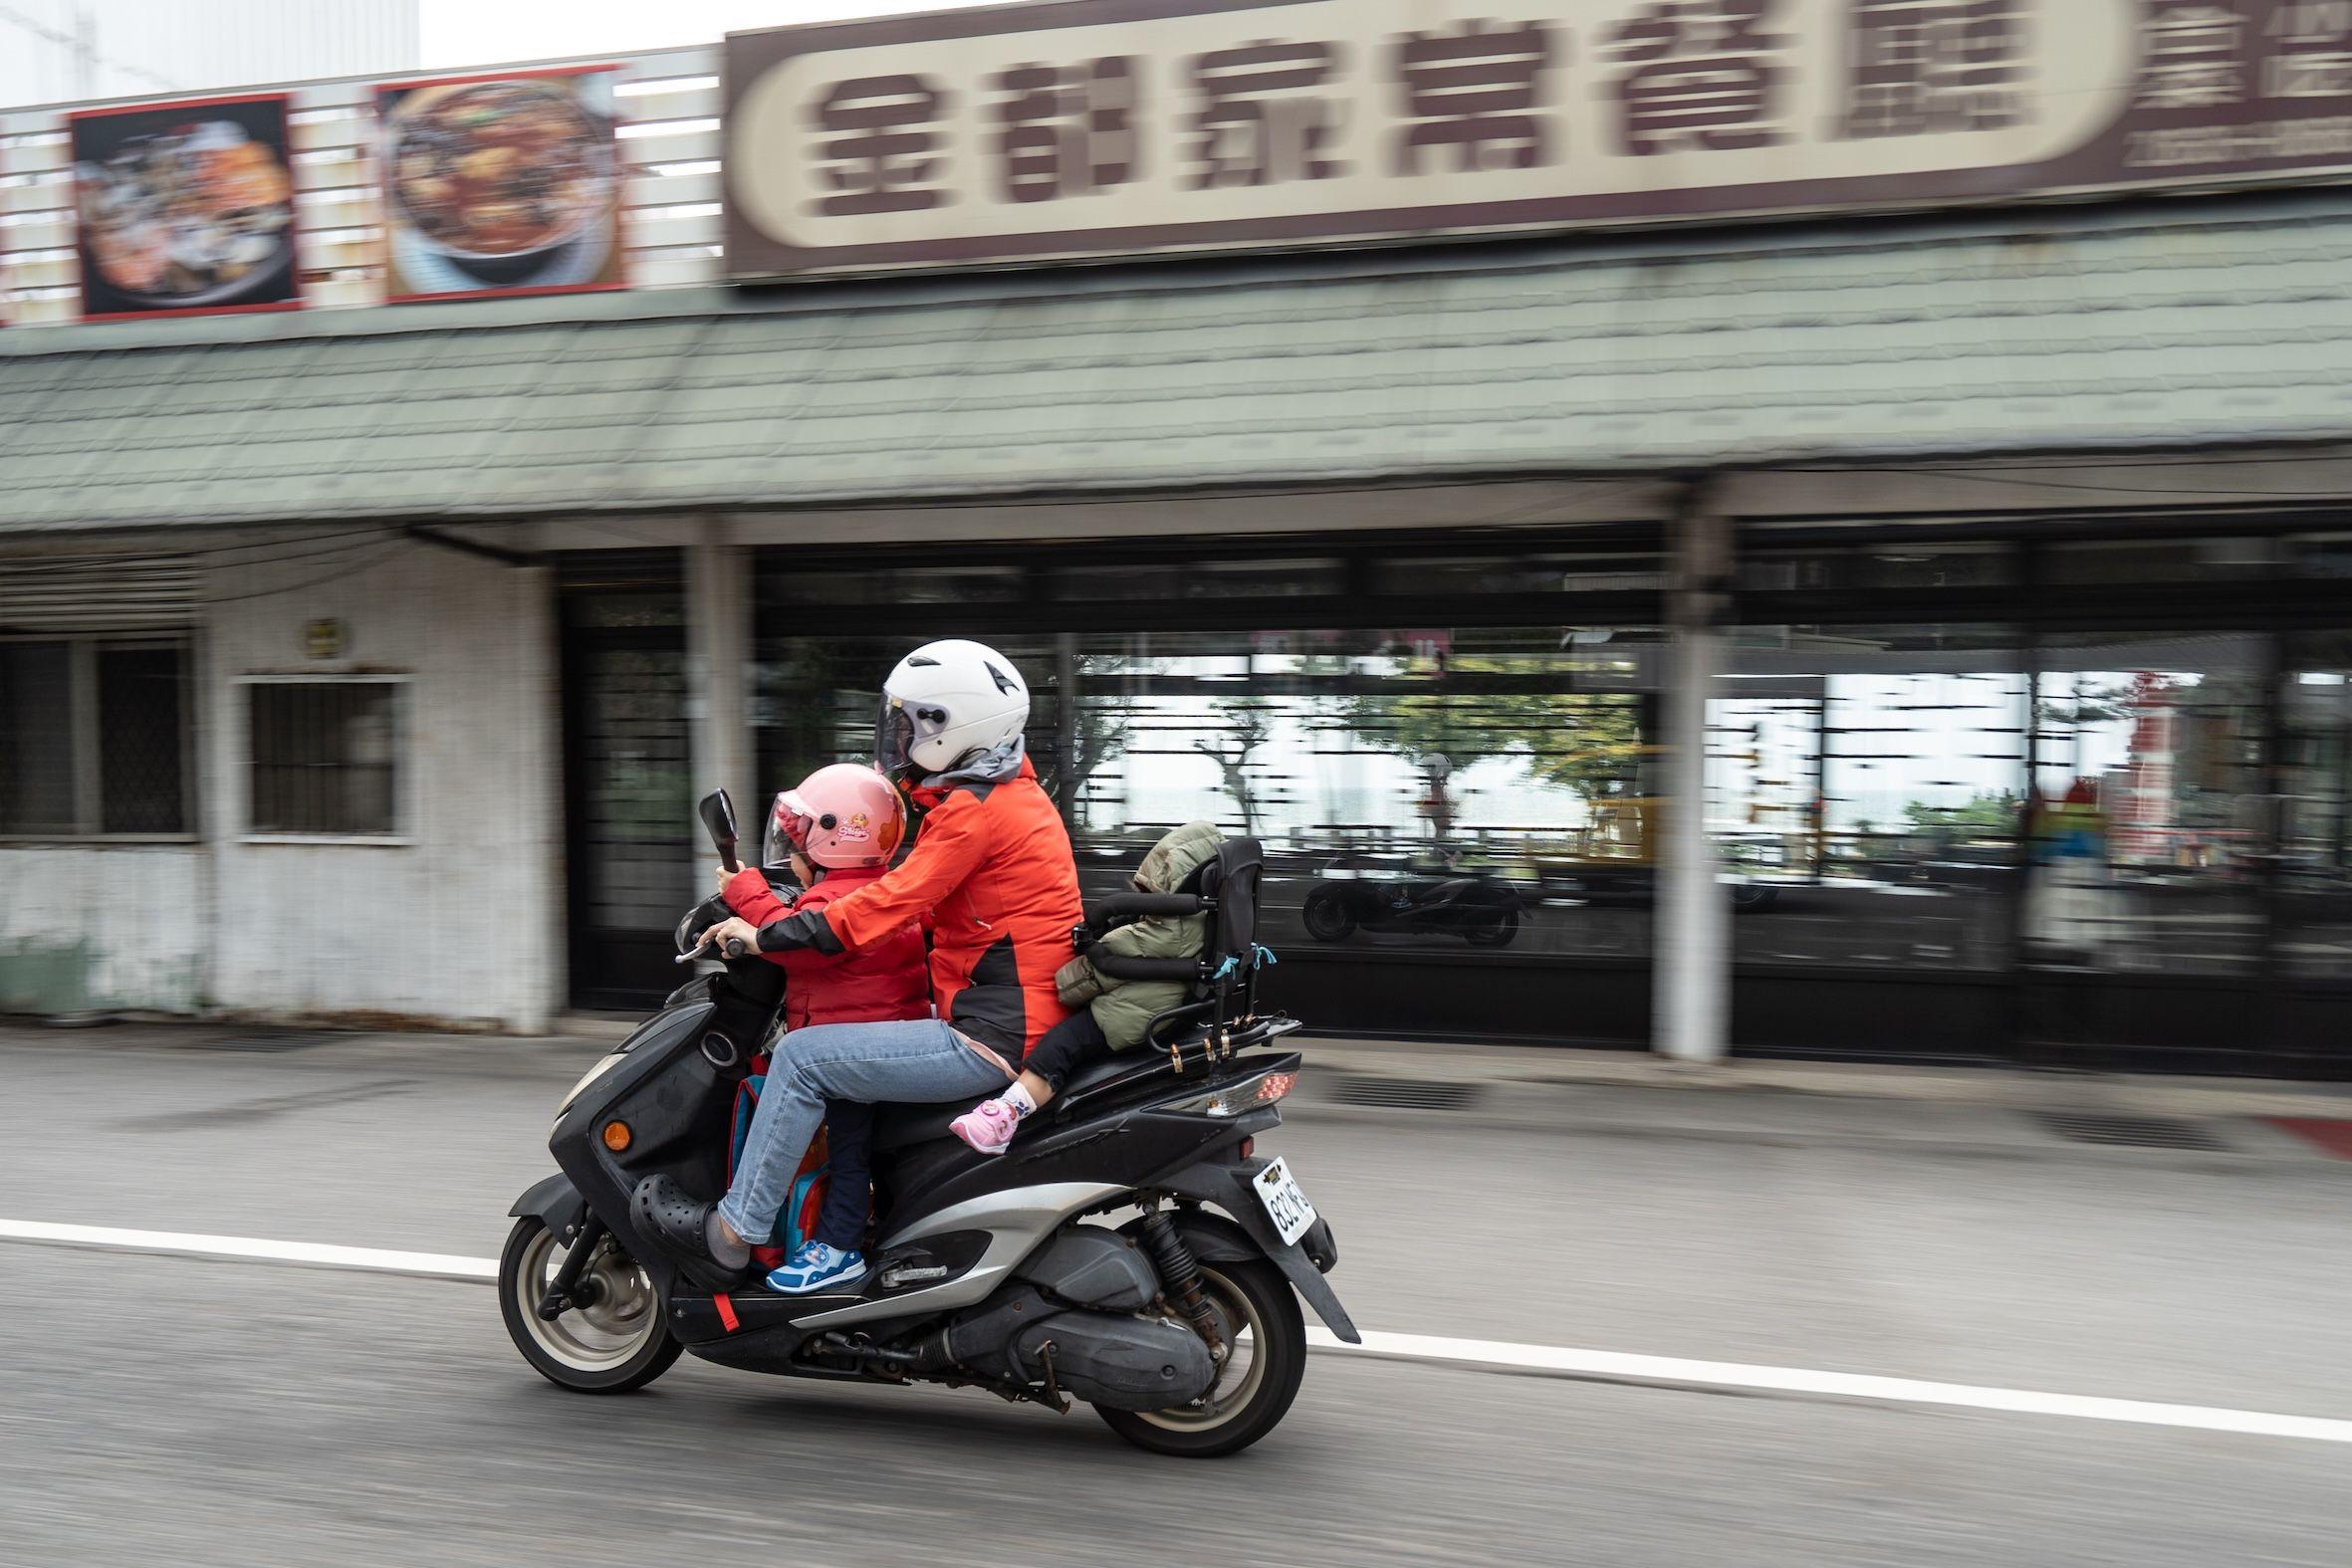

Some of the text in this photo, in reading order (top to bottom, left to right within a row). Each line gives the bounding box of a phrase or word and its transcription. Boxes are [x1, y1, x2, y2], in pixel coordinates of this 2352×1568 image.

[801, 0, 2027, 218] 金都家常餐廳
